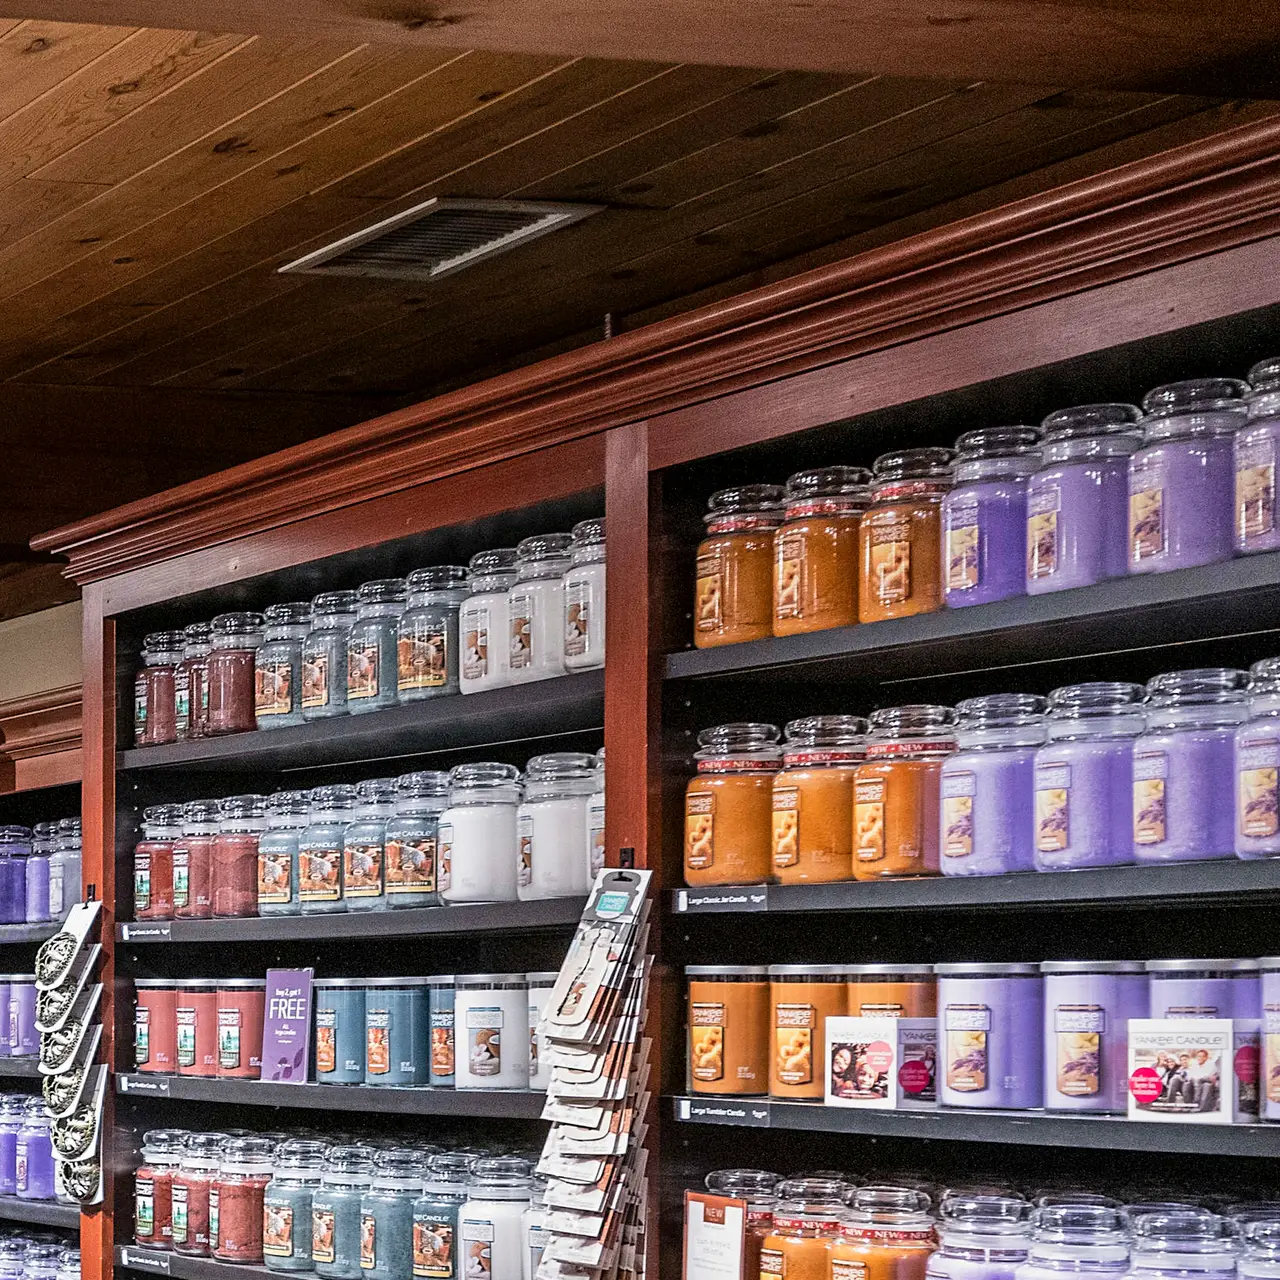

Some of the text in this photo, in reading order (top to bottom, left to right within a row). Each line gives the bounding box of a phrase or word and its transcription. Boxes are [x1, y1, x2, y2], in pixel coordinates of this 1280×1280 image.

[732, 759, 755, 769] NEW
[401, 830, 433, 839] CANDLE
[269, 998, 306, 1020] FREE
[692, 1016, 723, 1025] CANDLE
[778, 1016, 811, 1026] CANDLE
[1176, 1034, 1223, 1045] CANDLE
[705, 1206, 724, 1219] NEW
[423, 1214, 450, 1222] CANDLE
[776, 1219, 825, 1230] NEW NEW
[845, 1228, 864, 1237] NEW
[874, 1230, 900, 1239] NEW
